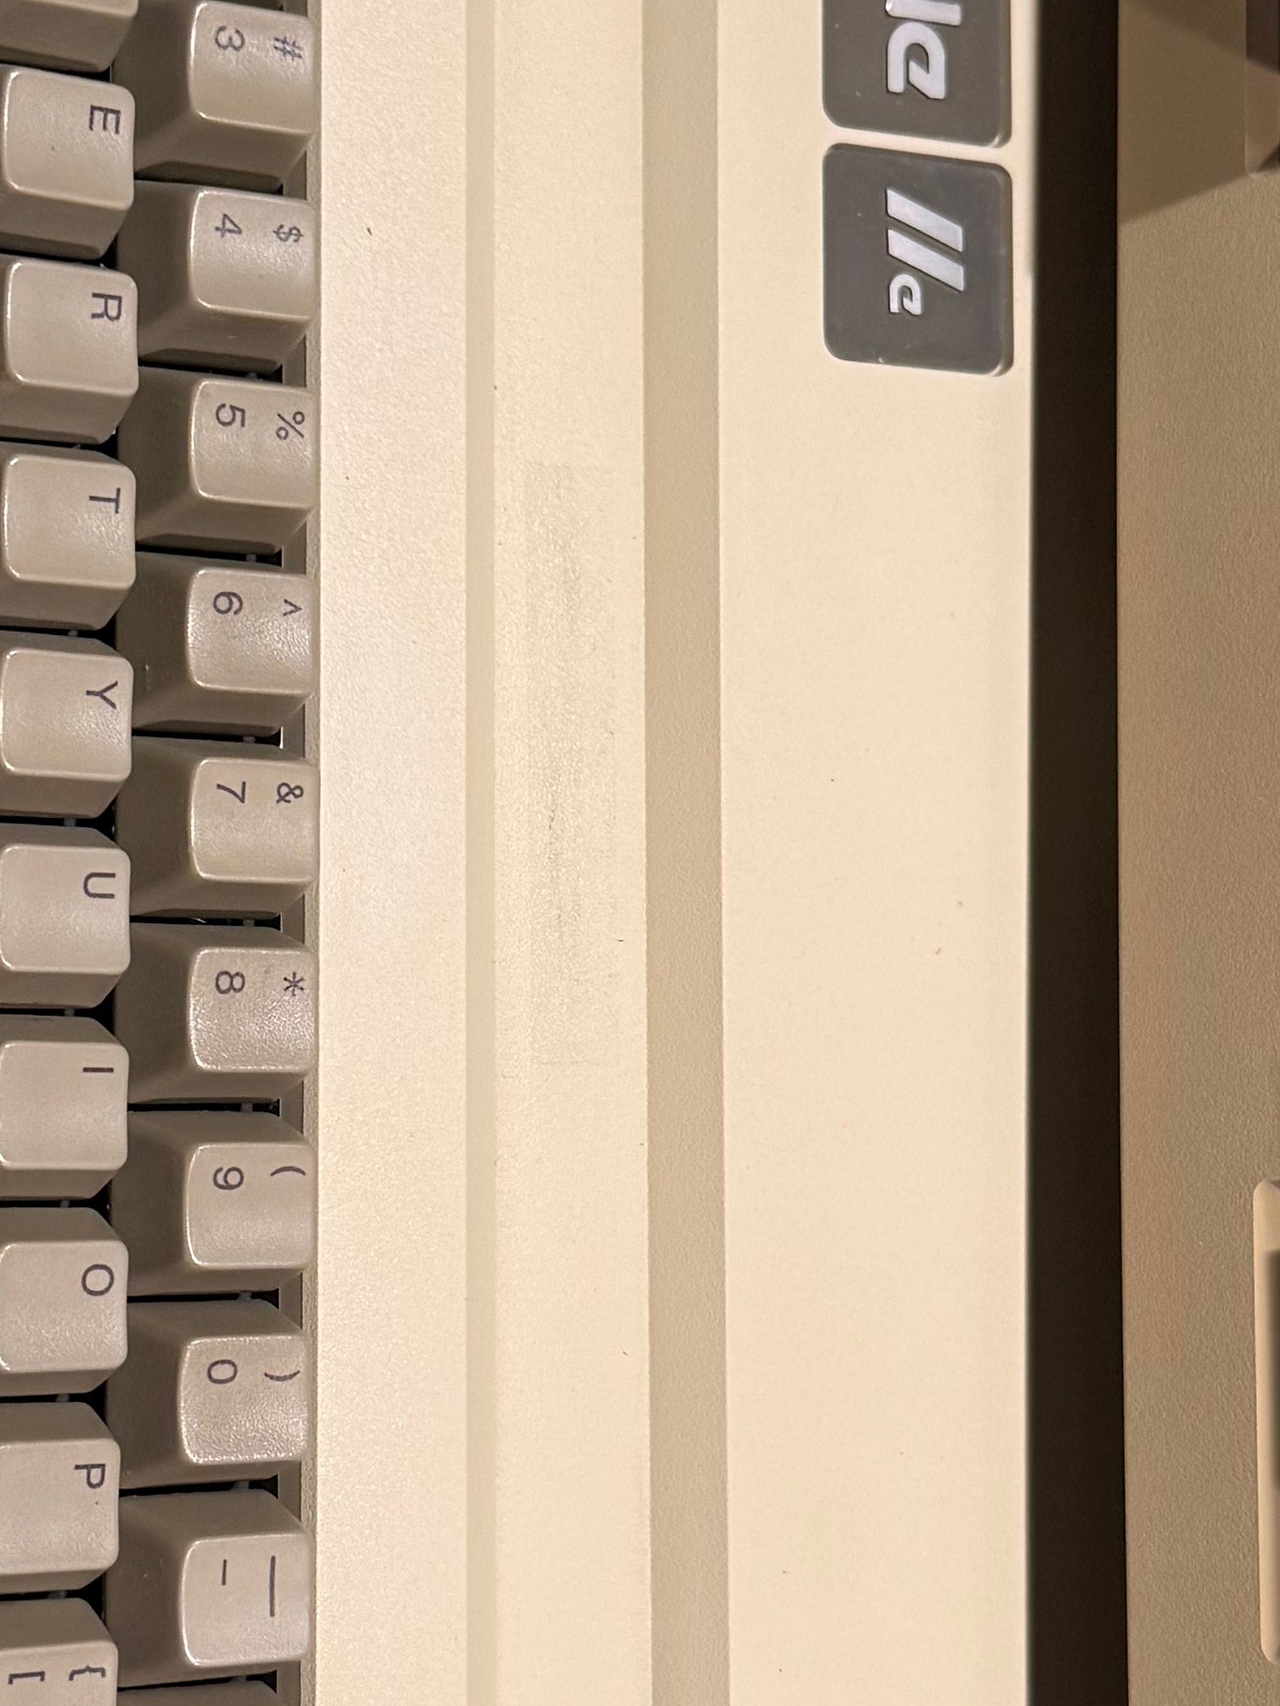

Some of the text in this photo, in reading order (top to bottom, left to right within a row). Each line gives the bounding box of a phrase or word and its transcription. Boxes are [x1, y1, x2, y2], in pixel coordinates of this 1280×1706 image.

[214, 26, 245, 52] 3
[273, 36, 303, 61] #
[89, 105, 121, 135] E
[215, 213, 242, 238] 4
[273, 224, 304, 243] $
[91, 293, 122, 322] R
[215, 403, 245, 427] 5
[276, 411, 305, 440] %
[89, 488, 121, 514] T
[213, 591, 243, 615] 6
[86, 681, 118, 709] Y
[216, 781, 246, 803] 7
[276, 782, 304, 804] &
[83, 872, 116, 899] U
[215, 971, 245, 994] 8
[213, 1167, 244, 1190] 9
[270, 1166, 306, 1176] (
[81, 1264, 114, 1296] O
[207, 1359, 238, 1384] 0
[264, 1370, 300, 1382] )
[74, 1463, 106, 1489] P
[8, 1671, 45, 1685] [
[69, 1665, 106, 1681] {
